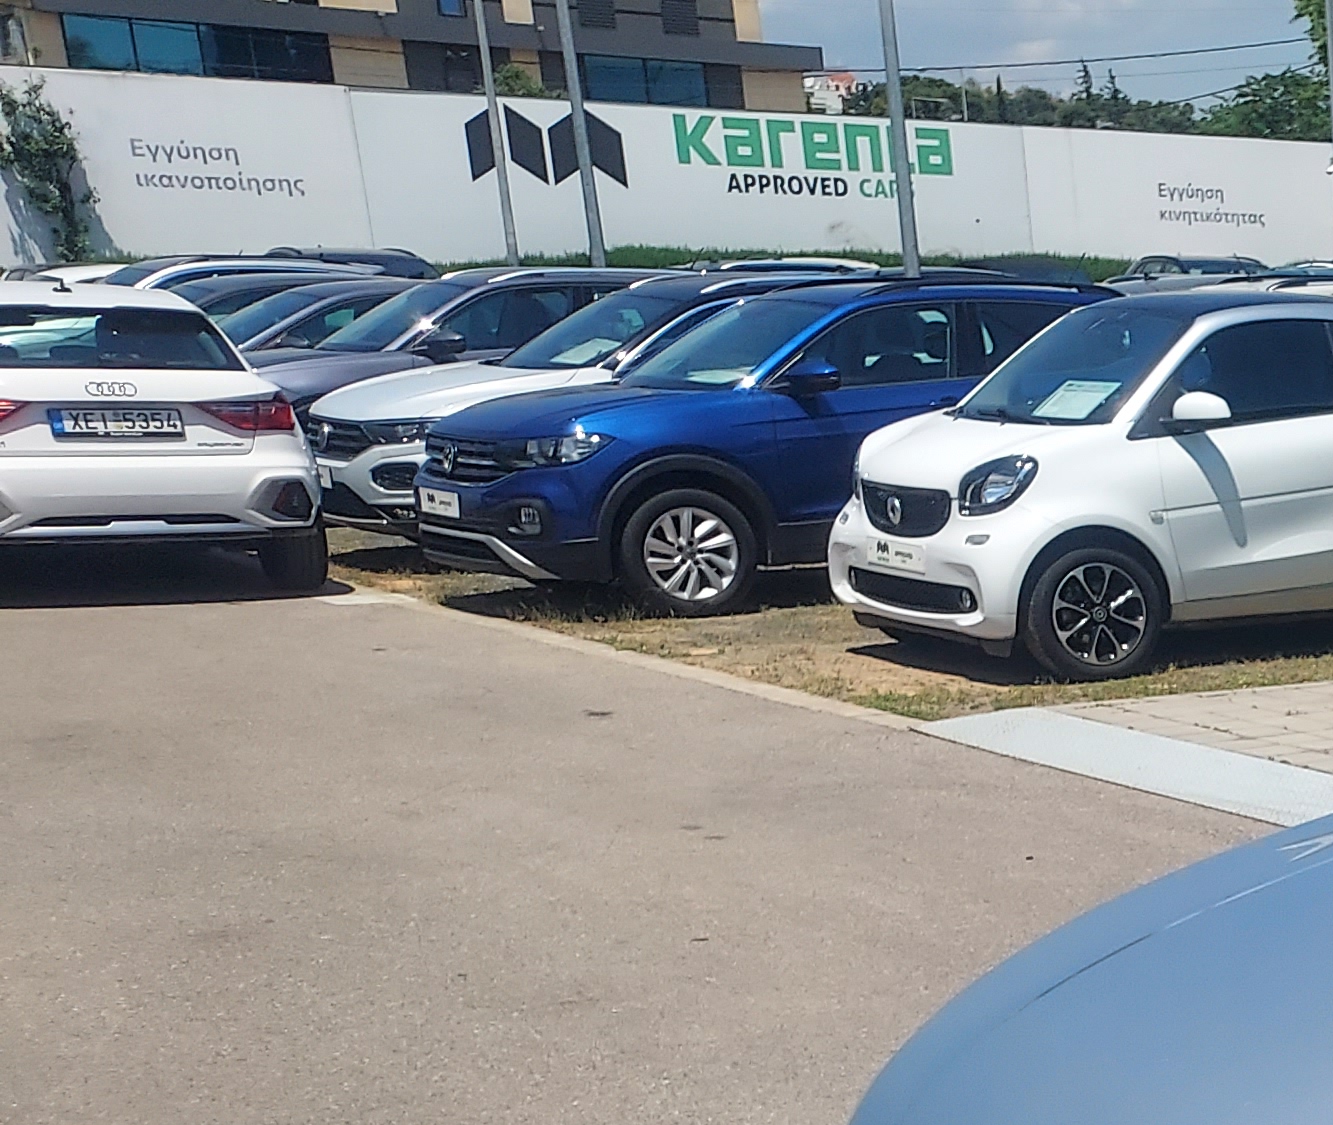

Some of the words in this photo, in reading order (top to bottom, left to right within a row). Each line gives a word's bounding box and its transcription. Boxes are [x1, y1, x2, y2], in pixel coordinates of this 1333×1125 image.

[129, 138, 240, 166] Εγγύηση
[136, 171, 305, 197] ικανοποίησης
[727, 173, 849, 198] APPROVED
[859, 178, 914, 200] CA
[1158, 182, 1224, 204] Εγγύηση
[1159, 207, 1266, 228] κινητικότητας
